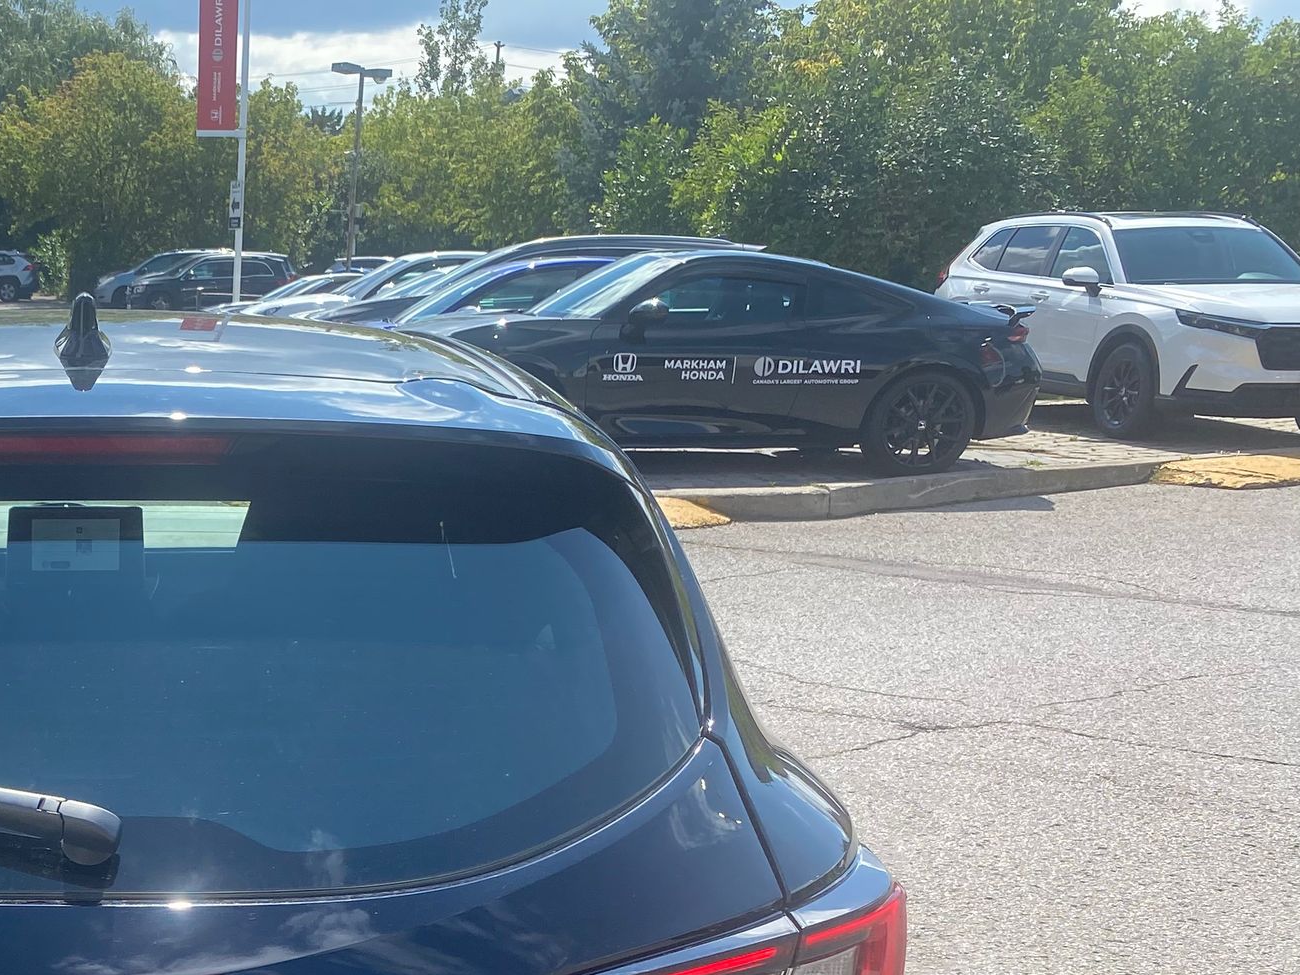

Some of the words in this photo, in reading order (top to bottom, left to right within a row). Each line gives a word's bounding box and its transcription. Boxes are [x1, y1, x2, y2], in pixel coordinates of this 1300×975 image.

[214, 0, 223, 46] DILAWR
[664, 359, 726, 369] MARKHAM
[777, 359, 861, 374] DILAWRI
[602, 373, 644, 382] HONDA
[681, 370, 725, 380] HONDA
